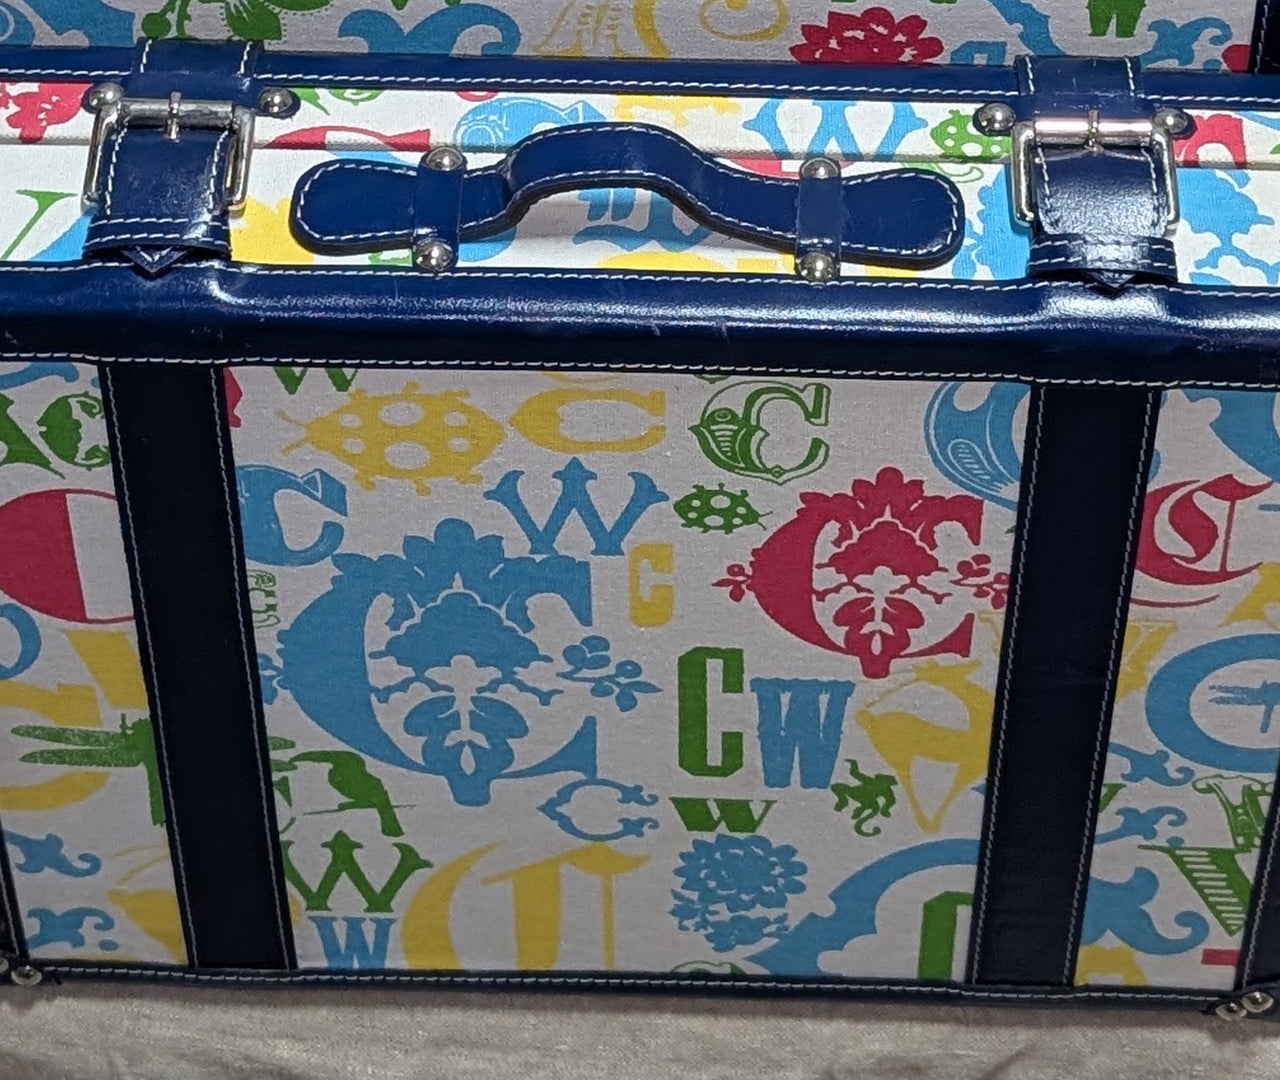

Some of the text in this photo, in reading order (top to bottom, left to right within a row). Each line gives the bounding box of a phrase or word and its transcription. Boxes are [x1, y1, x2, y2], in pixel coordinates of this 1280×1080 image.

[508, 388, 668, 454] C
[688, 380, 832, 486] C
[483, 456, 671, 556] W
[669, 796, 778, 833] W
